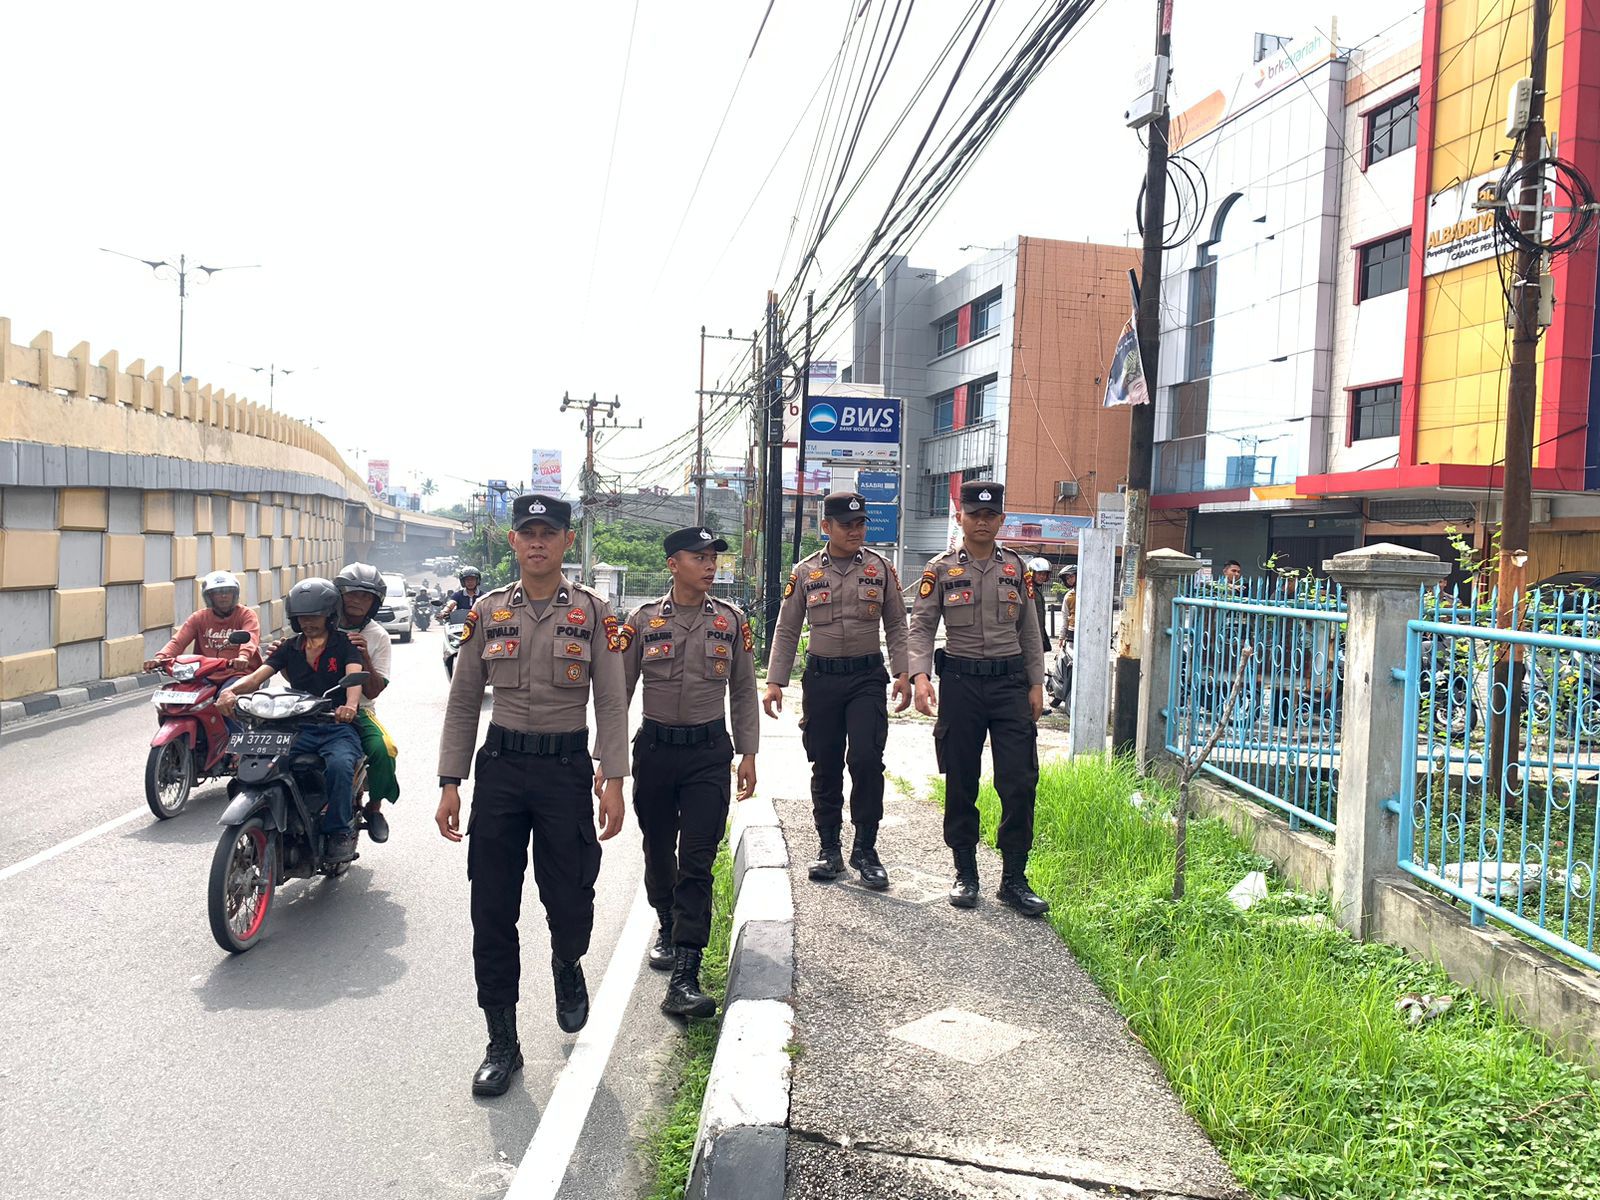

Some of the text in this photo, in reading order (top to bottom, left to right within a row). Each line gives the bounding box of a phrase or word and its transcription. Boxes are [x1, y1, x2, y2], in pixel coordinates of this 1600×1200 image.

[840, 407, 894, 428] BWS
[858, 577, 883, 586] POLRI
[486, 626, 519, 639] RIVALDI
[556, 625, 592, 640] POLRI
[706, 630, 734, 642] POLRI
[247, 735, 272, 745] 3772
